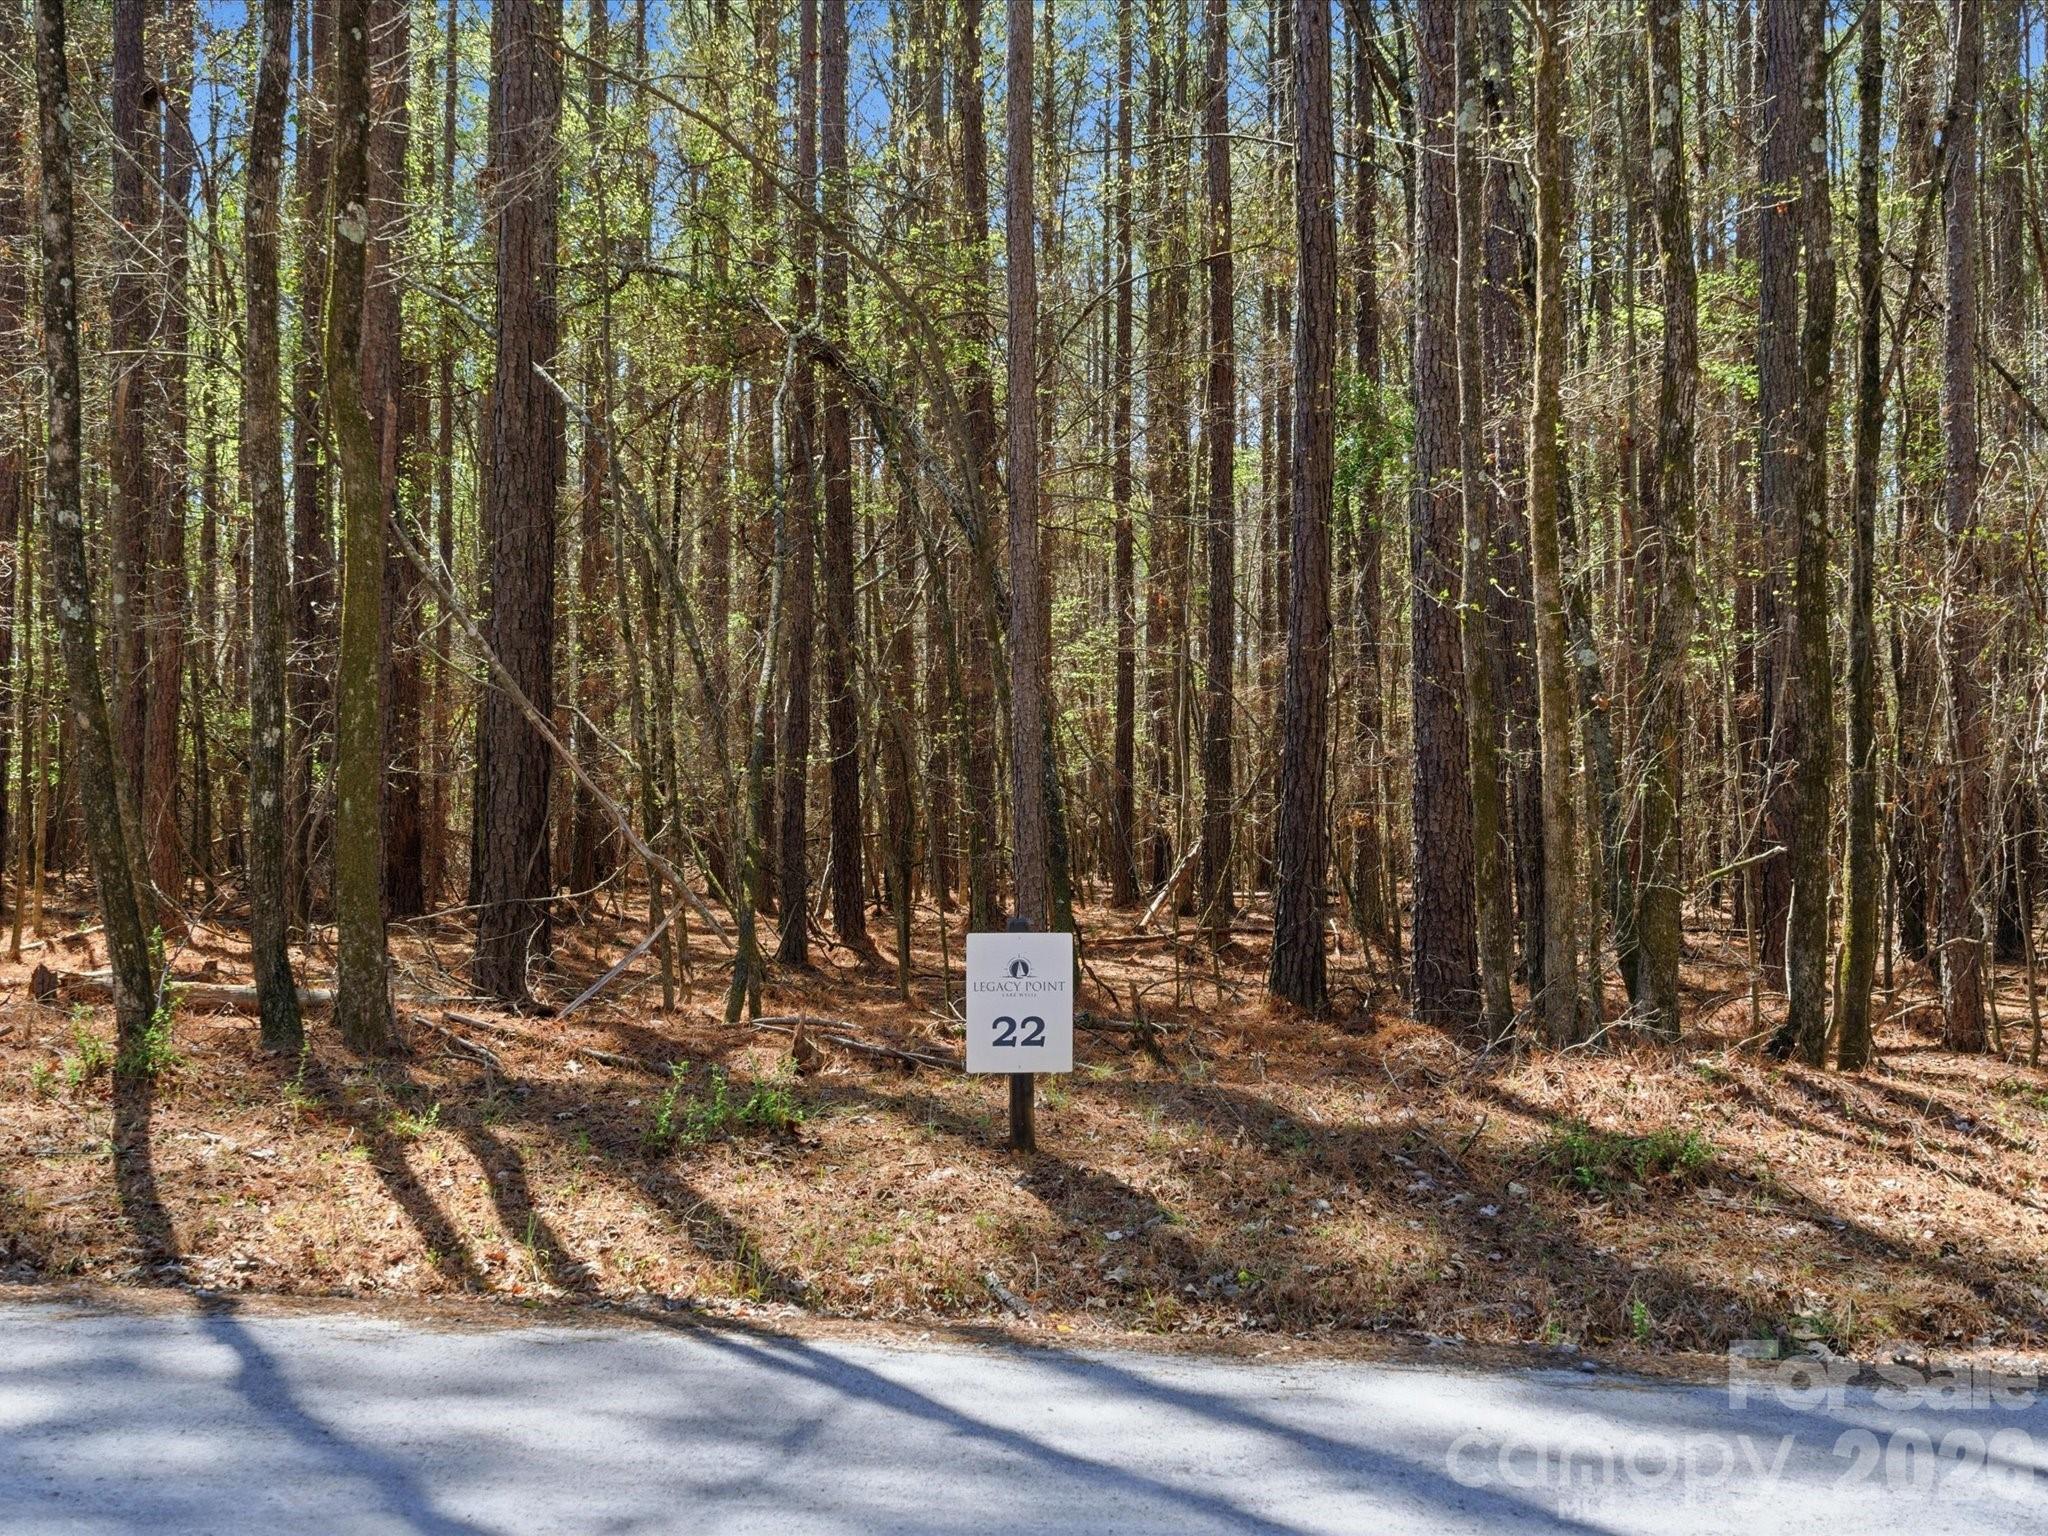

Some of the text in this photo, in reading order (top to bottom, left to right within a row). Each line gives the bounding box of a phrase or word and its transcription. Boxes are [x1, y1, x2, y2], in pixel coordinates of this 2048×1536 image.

[973, 981, 1066, 992] LEGACY POINT
[992, 1015, 1046, 1047] 22
